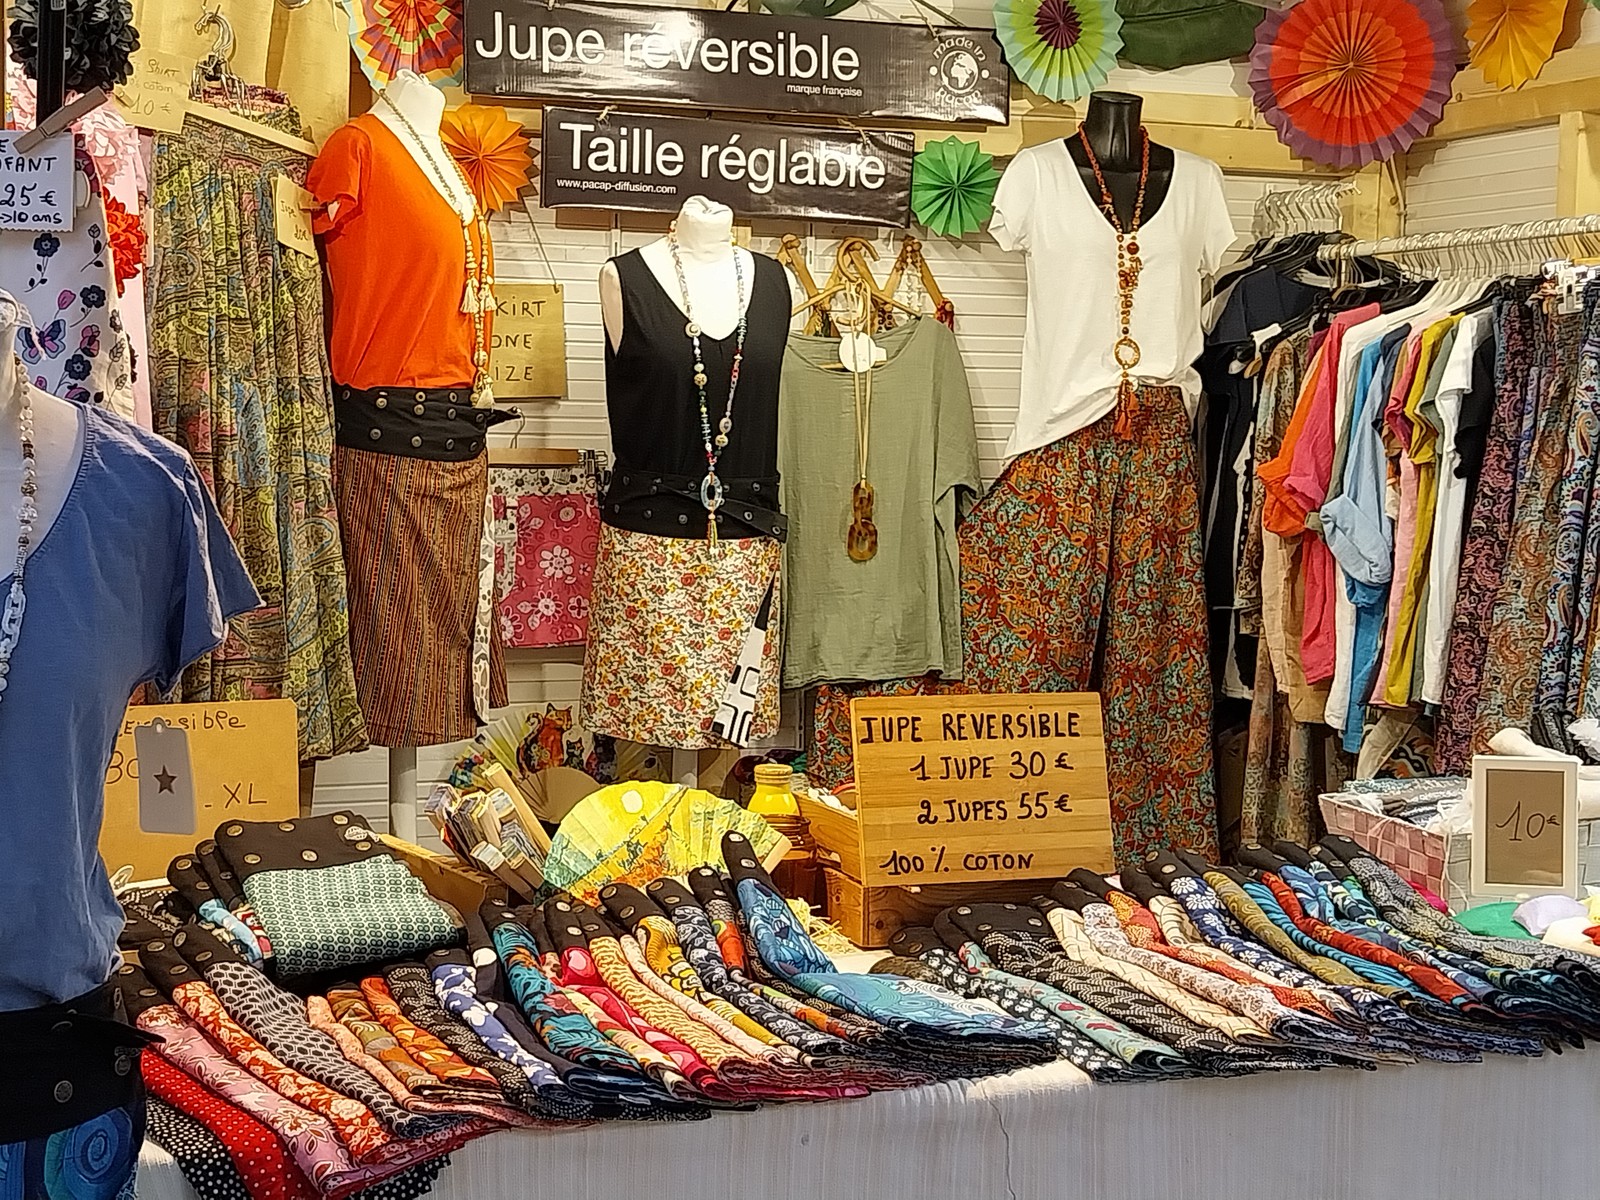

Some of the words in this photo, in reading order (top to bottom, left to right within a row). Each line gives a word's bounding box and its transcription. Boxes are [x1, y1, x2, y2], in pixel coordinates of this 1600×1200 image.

[475, 10, 606, 74] Jupe
[623, 22, 860, 82] réversible
[933, 36, 974, 60] made
[786, 84, 821, 96] marque
[822, 84, 863, 98] française
[130, 93, 154, 116] 10
[0, 156, 57, 172] FANT
[559, 121, 685, 177] Taille
[700, 133, 887, 195] réglable
[0, 182, 38, 207] 25
[39, 190, 57, 207] €
[556, 178, 677, 194] www.pacap-diffusion.com
[859, 716, 924, 744] JUPE
[909, 755, 931, 782] 1
[939, 755, 995, 780] JUPE
[1009, 750, 1046, 780] 30
[1053, 752, 1074, 771] €
[222, 782, 268, 809] XL
[917, 799, 939, 825] 2
[943, 798, 1008, 823] JUPES
[879, 850, 925, 876] 100
[962, 853, 1035, 871] COTON
